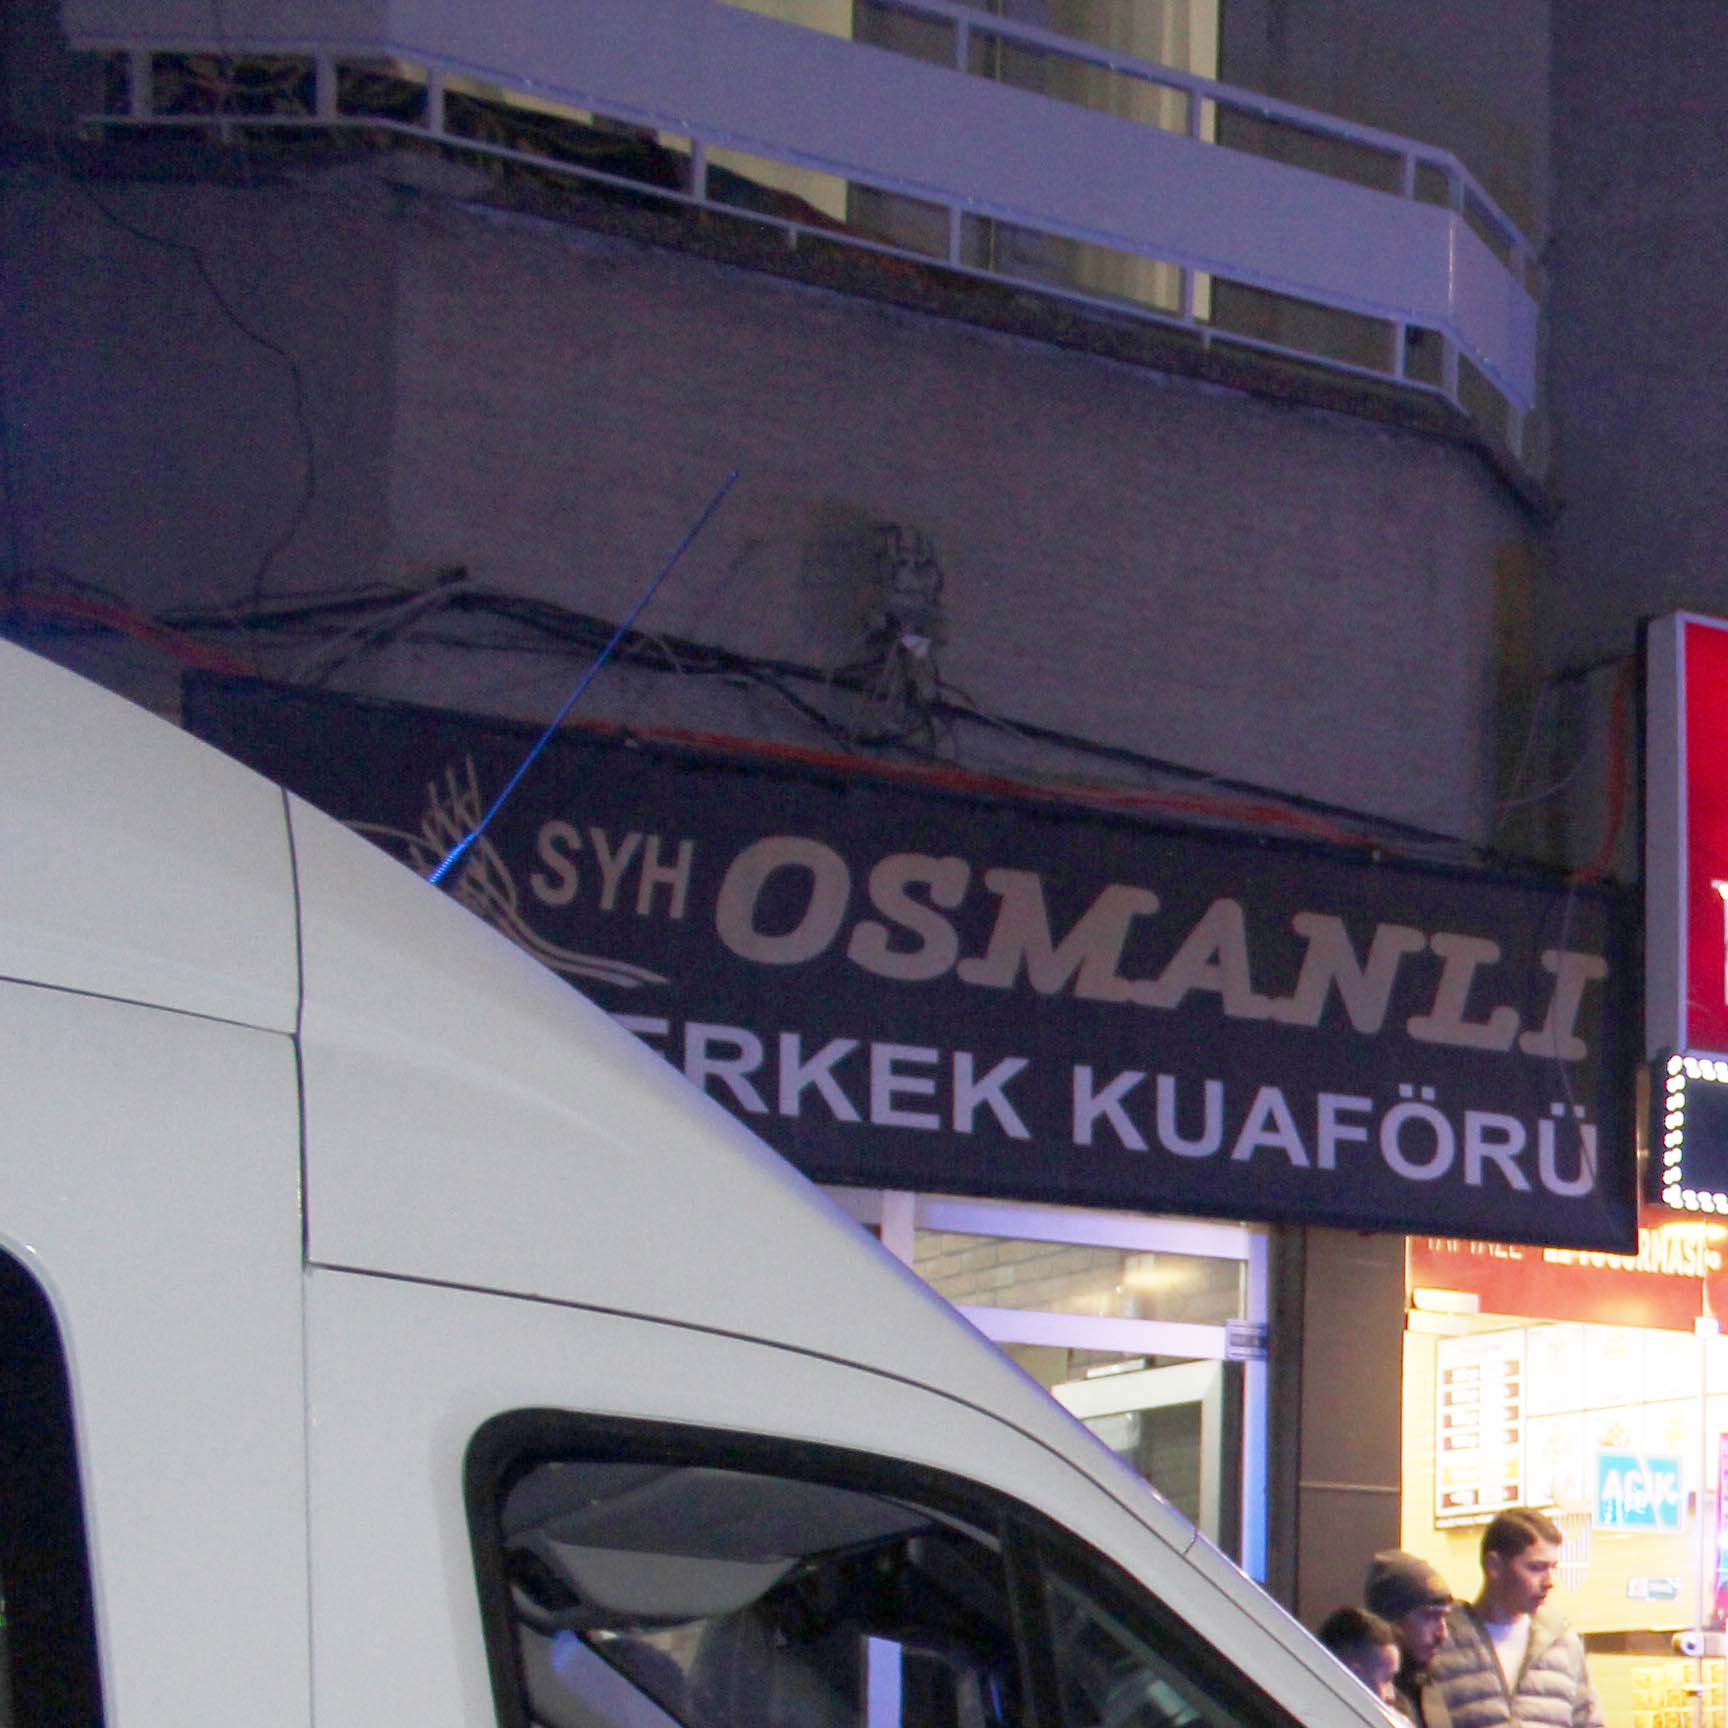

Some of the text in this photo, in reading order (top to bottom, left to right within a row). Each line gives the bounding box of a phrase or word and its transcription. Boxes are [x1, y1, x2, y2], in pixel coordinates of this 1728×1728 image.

[530, 820, 1608, 1062] SYH OSMANLI
[1072, 1065, 1598, 1198] KUAFÖRÜ
